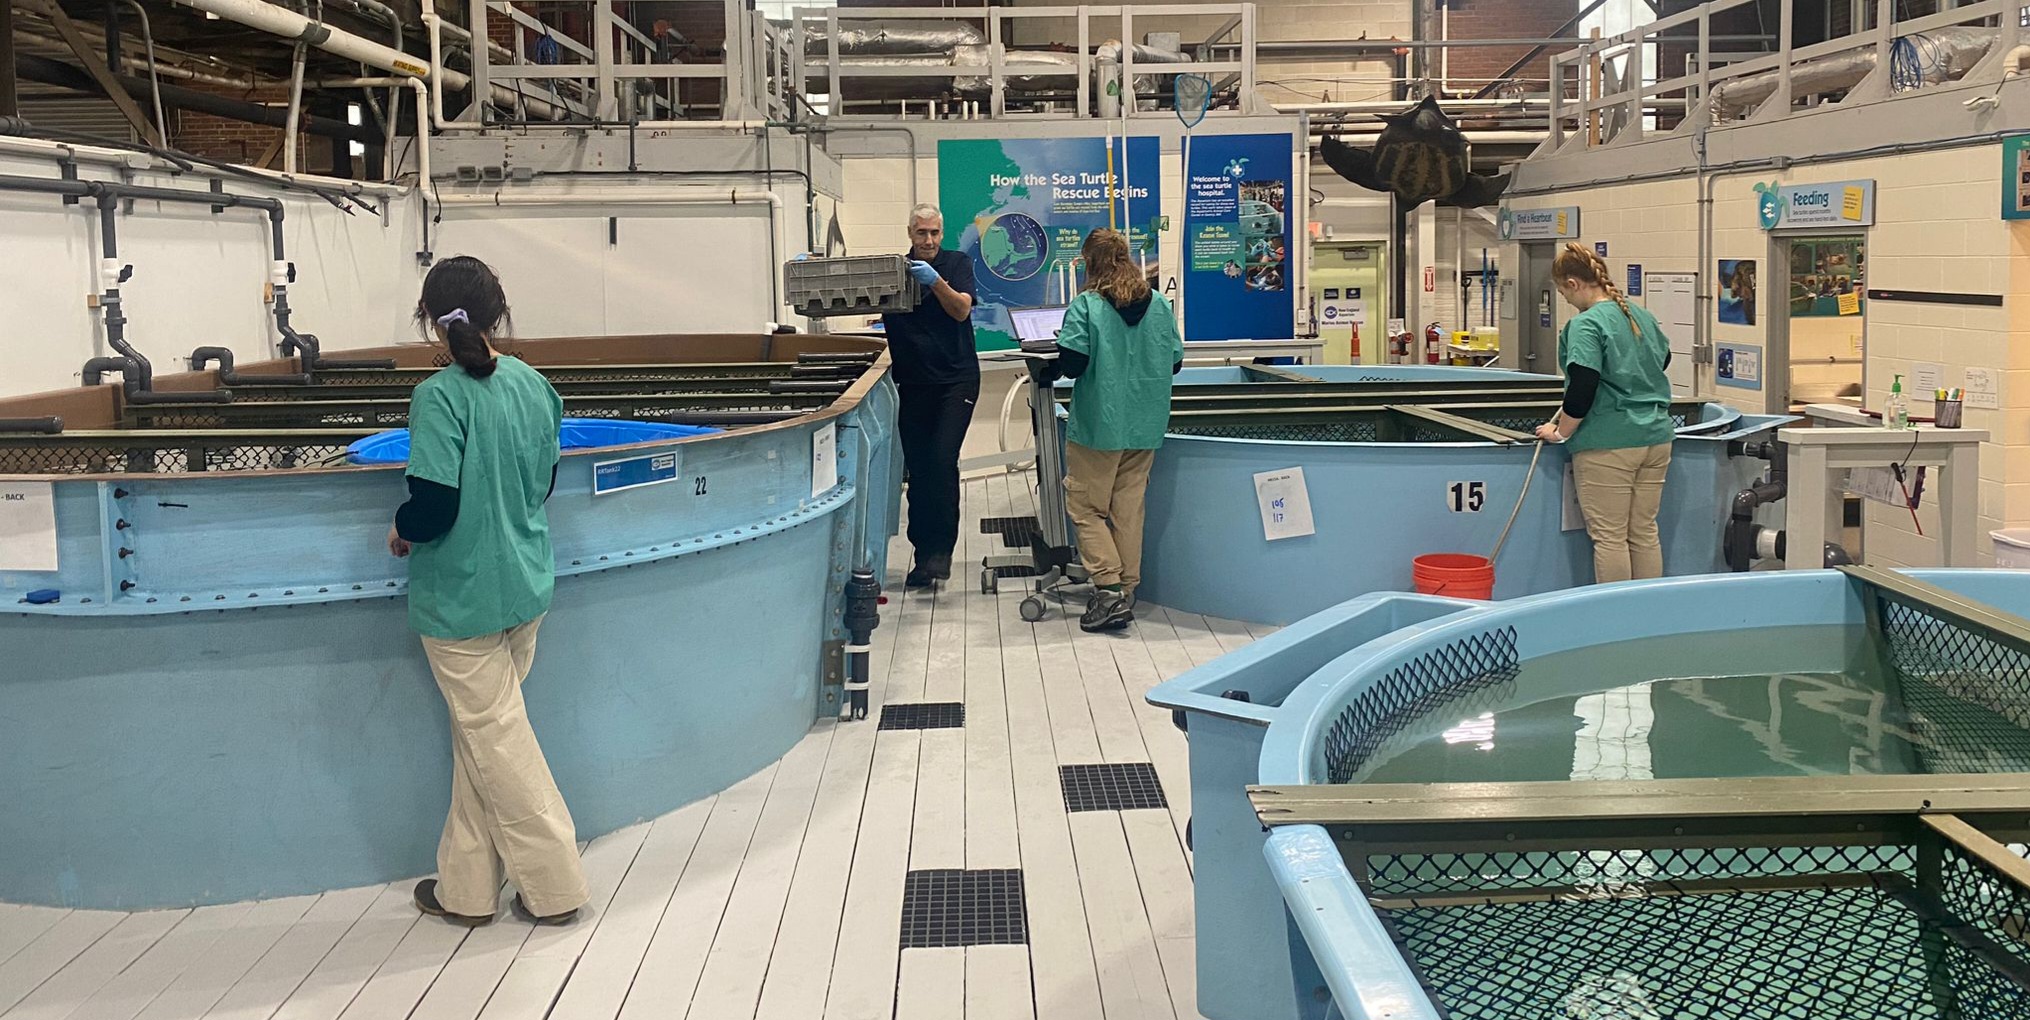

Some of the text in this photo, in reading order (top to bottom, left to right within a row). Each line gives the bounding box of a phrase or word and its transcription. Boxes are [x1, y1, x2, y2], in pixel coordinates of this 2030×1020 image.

[990, 171, 1118, 187] How the Sea Turtle
[1053, 187, 1100, 199] Rescue
[1793, 190, 1829, 207] Feeding
[1517, 213, 1527, 223] Find
[1530, 212, 1552, 223] Heartbeat
[1059, 228, 1071, 236] Why
[695, 476, 707, 496] 22
[5, 493, 25, 501] BACK
[1451, 481, 1484, 512] 15
